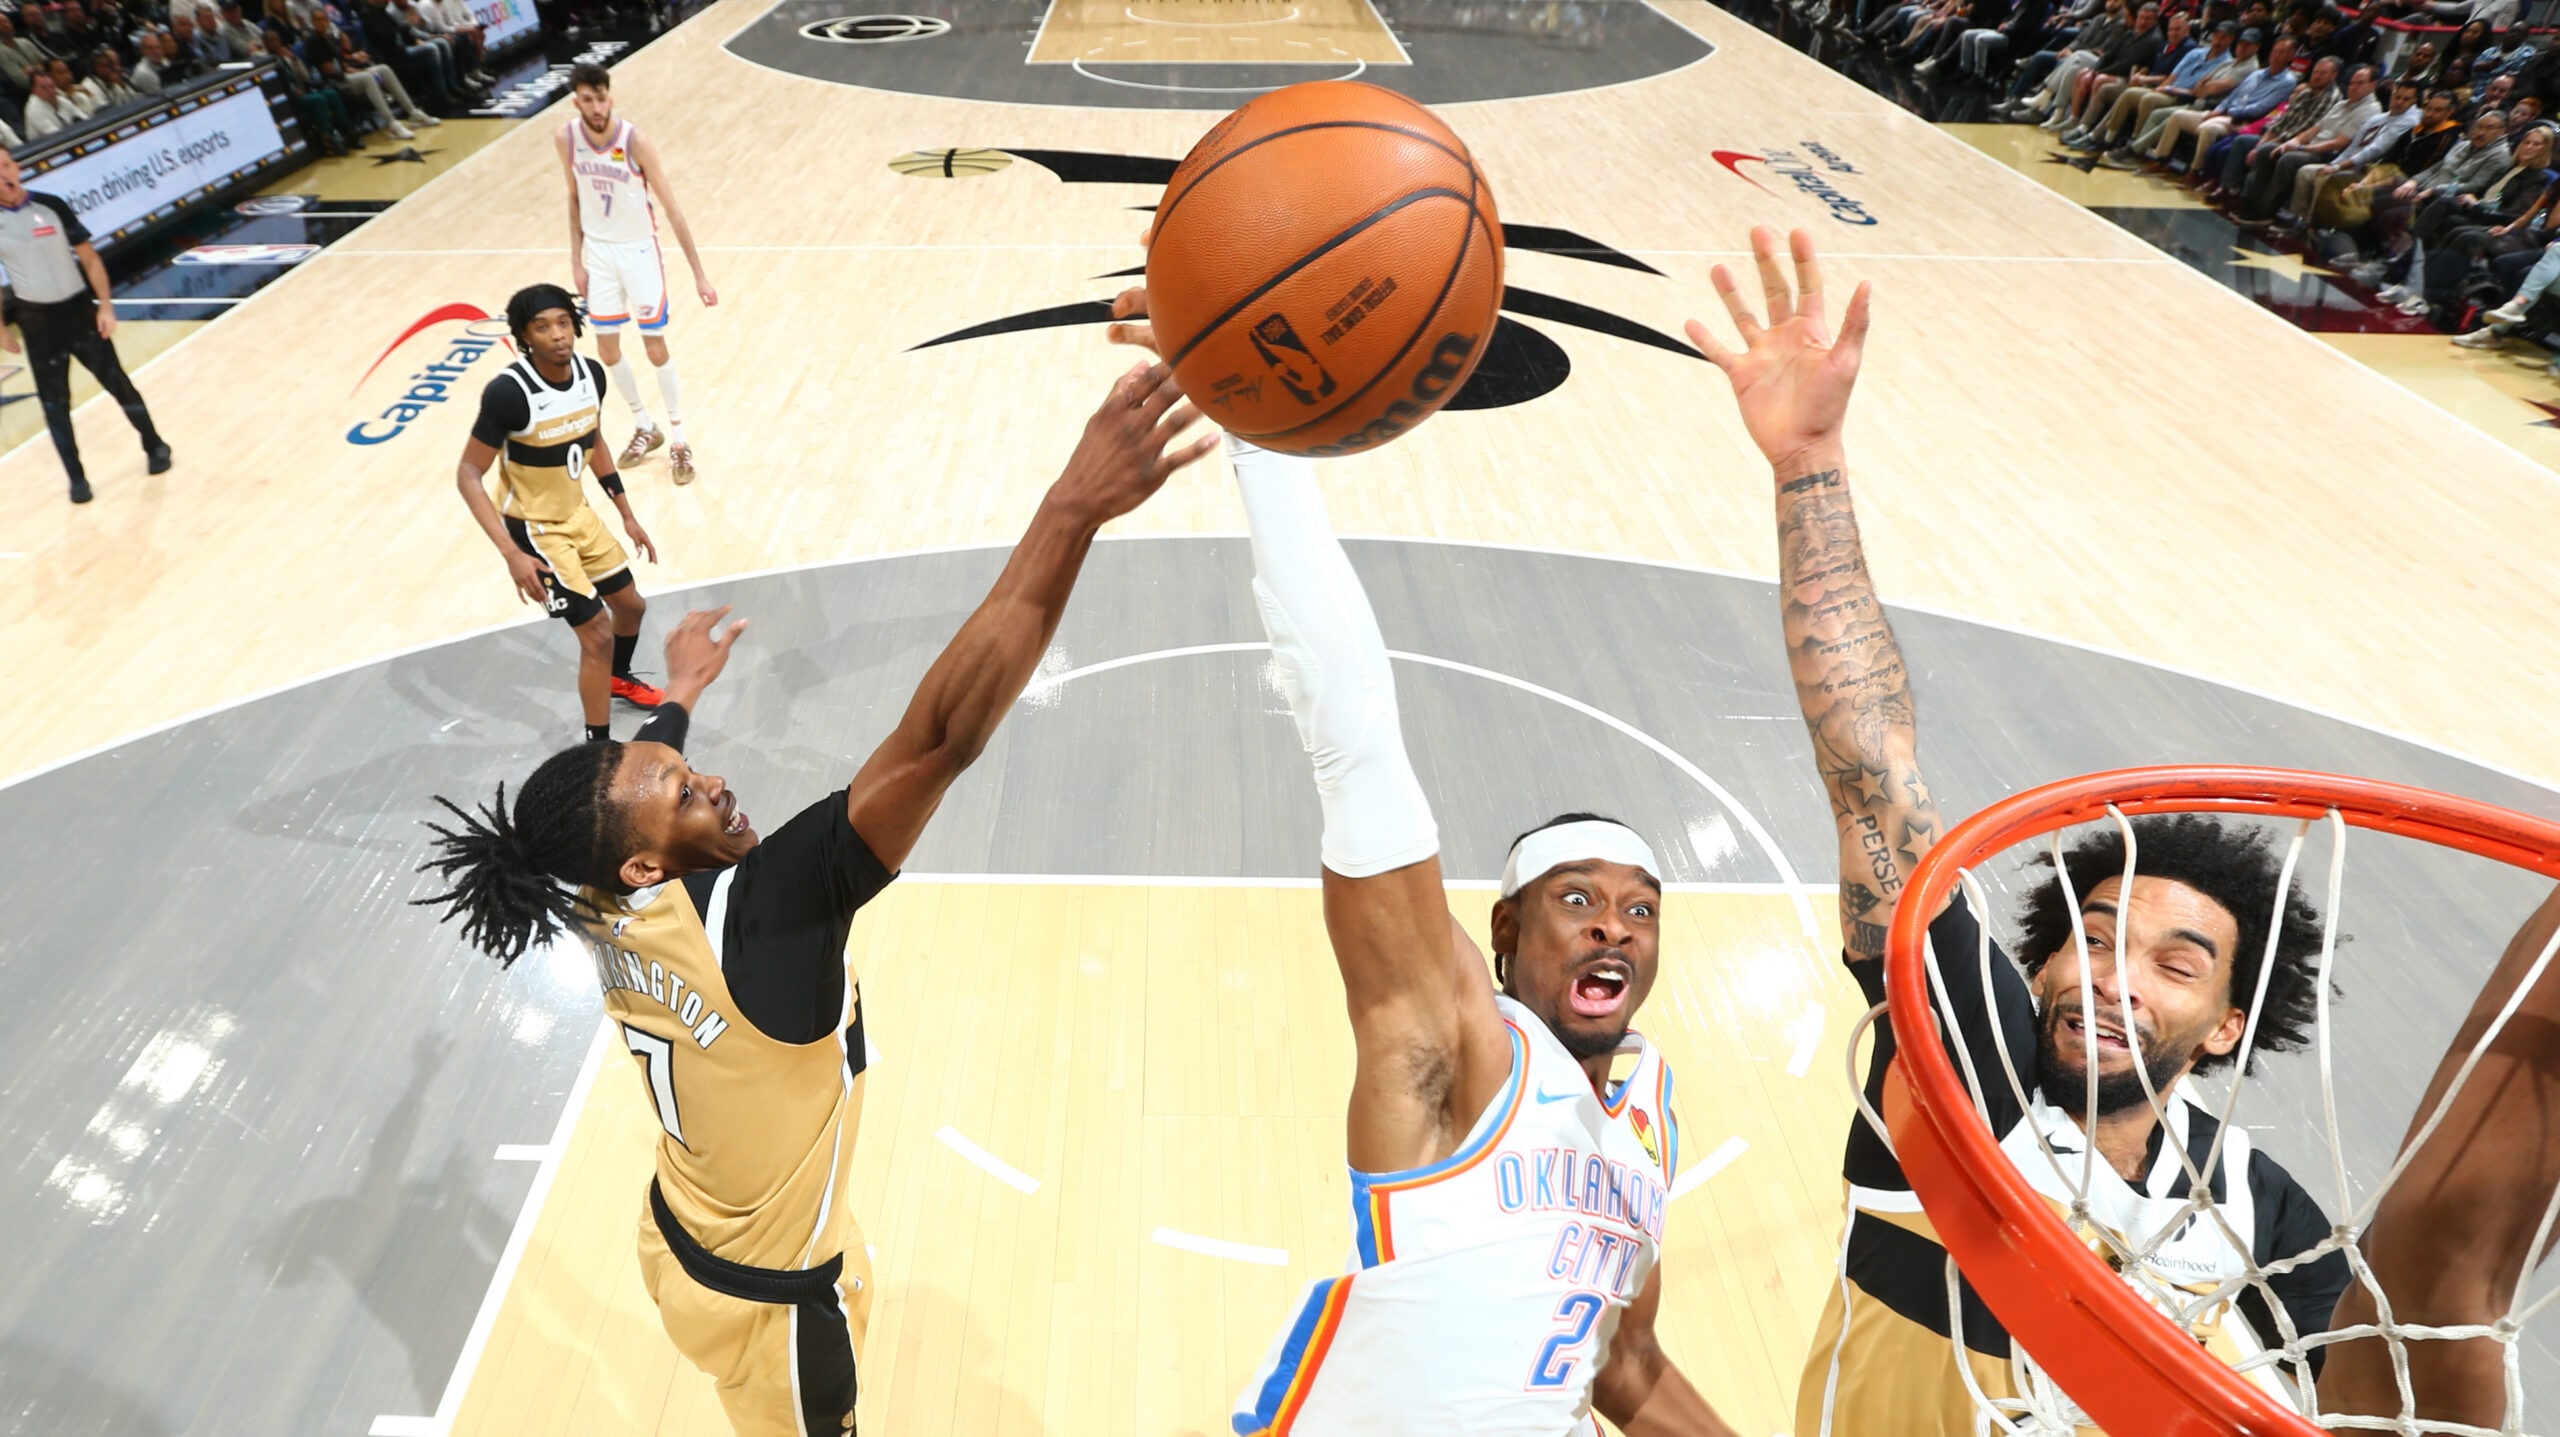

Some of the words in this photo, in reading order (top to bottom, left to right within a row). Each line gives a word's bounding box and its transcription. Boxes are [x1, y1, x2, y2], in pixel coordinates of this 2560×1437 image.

[102, 164, 155, 202] driving
[149, 149, 181, 177] U.S.
[179, 129, 231, 167] exports
[601, 194, 612, 217] 7
[345, 338, 497, 445] Capital
[538, 412, 596, 440] washington
[566, 443, 583, 480] 0
[1856, 814, 1903, 896] PERSE
[593, 941, 730, 1050] RRINGTON
[620, 1020, 692, 1154] 7
[1546, 1220, 1641, 1298] CITY
[1523, 1289, 1609, 1392] 2
